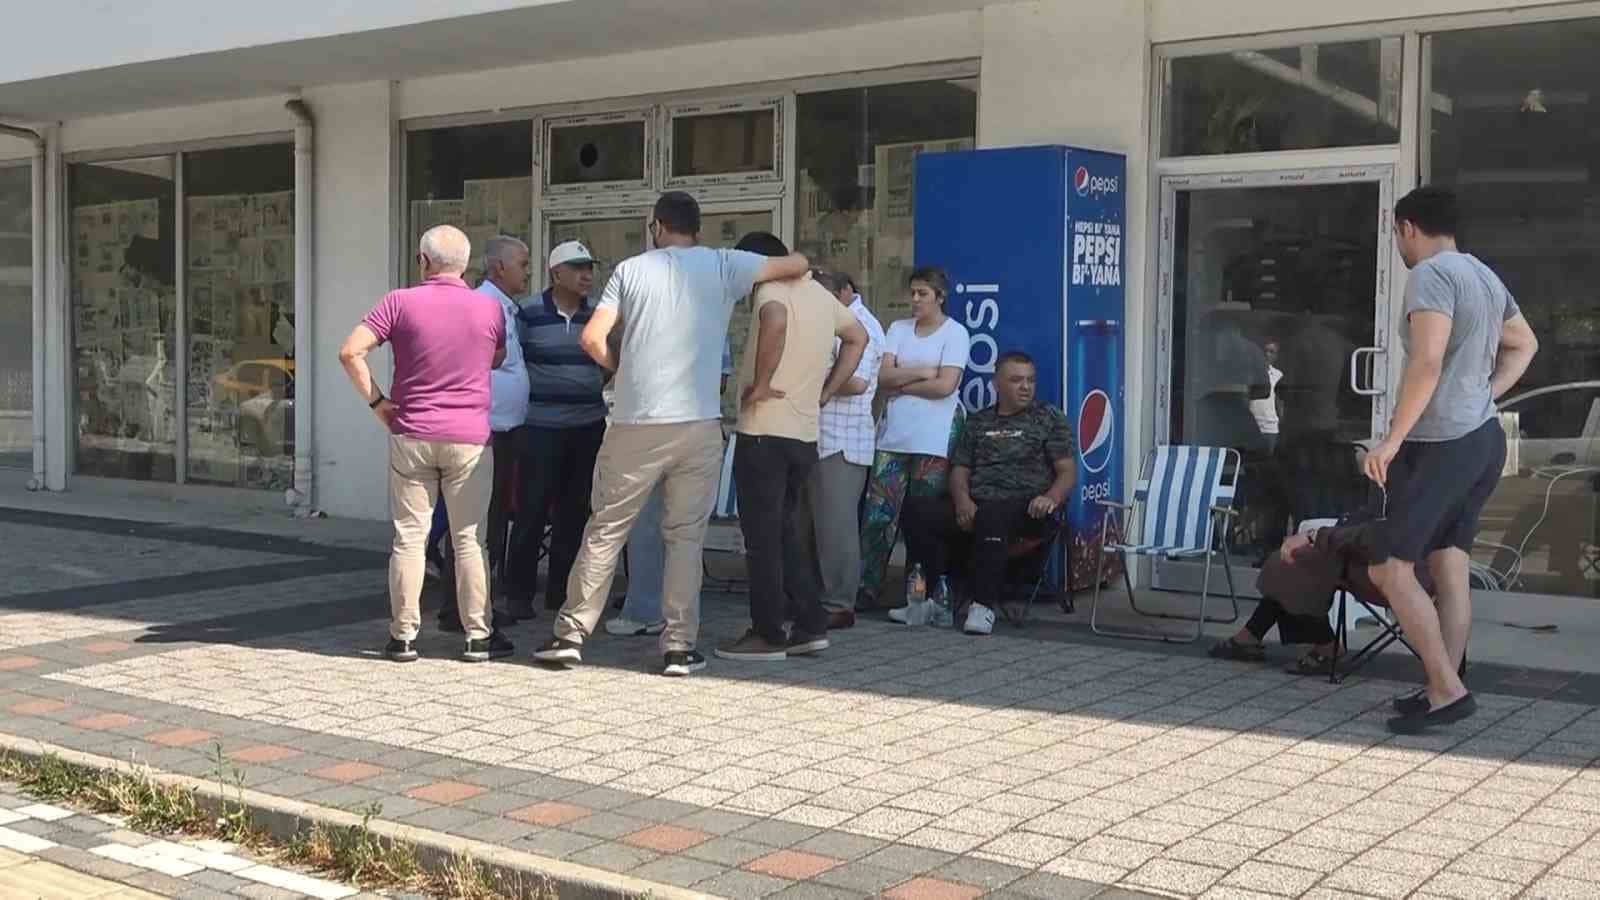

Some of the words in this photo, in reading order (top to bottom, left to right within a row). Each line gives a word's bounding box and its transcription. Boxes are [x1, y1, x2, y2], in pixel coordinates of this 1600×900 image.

[1090, 175, 1119, 194] pepsi
[1074, 234, 1120, 265] PEPSI
[1090, 264, 1120, 286] YANA
[955, 283, 999, 414] epsi
[1081, 477, 1111, 504] pepsi
